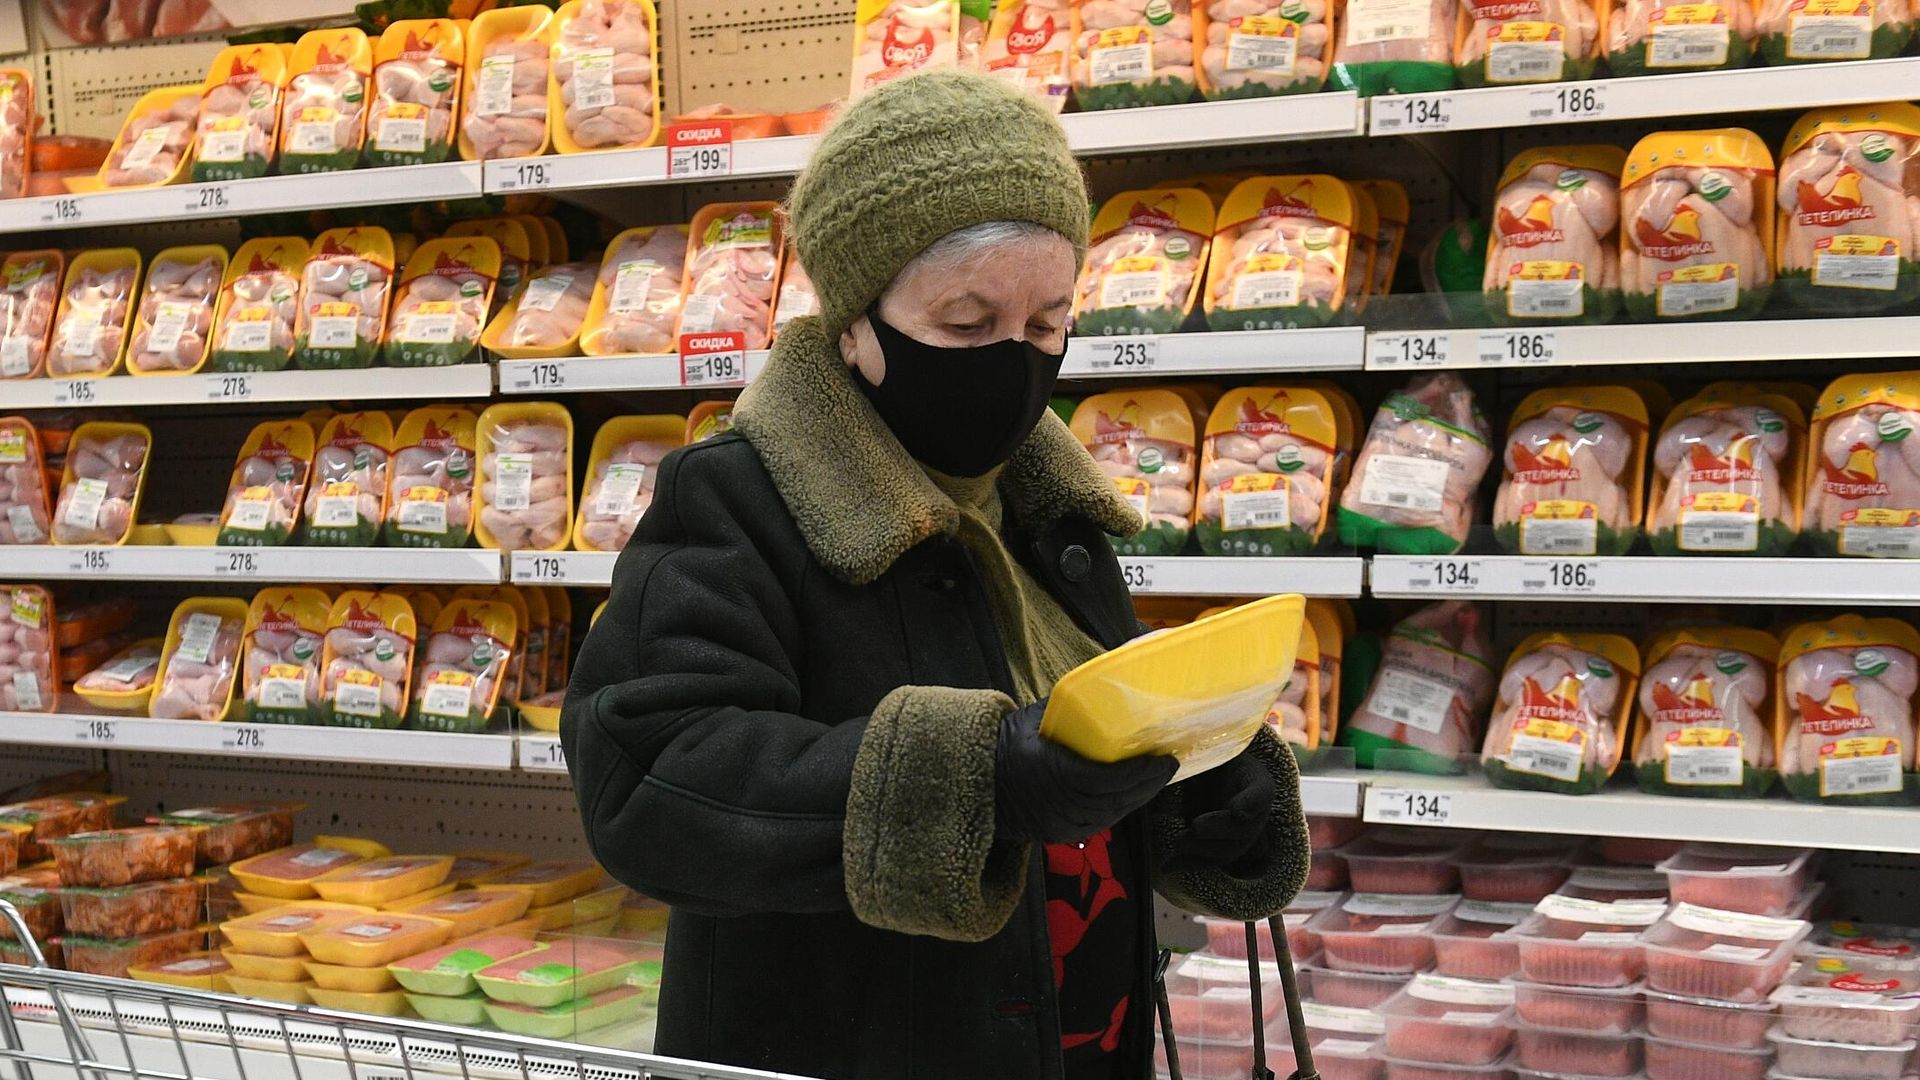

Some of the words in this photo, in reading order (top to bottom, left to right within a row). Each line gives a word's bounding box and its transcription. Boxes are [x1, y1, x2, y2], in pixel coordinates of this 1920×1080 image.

[1557, 88, 1596, 113] 186
[1405, 99, 1441, 124] 134
[676, 127, 723, 141] СКИДКА
[692, 149, 720, 170] 199
[518, 165, 544, 185] 179
[200, 188, 223, 207] 278
[55, 200, 77, 218] 185
[1799, 206, 1874, 226] ПЕТЕЛИНКА
[689, 337, 735, 350] СКИДКА
[1402, 337, 1438, 362] 134
[1507, 335, 1545, 358] 186
[1114, 343, 1147, 365] 253
[532, 364, 558, 385] 179
[705, 356, 733, 377] 199
[69, 382, 90, 399] 185
[223, 377, 246, 396] 278
[84, 550, 105, 568] 185
[229, 553, 252, 571] 278
[534, 558, 559, 578] 179
[1124, 565, 1144, 587] 53
[1434, 561, 1470, 585] 134
[1549, 563, 1588, 586] 186
[89, 721, 110, 738] 185
[1799, 715, 1875, 733] ПЕТЕЛИНКА
[237, 728, 259, 746] 278
[549, 743, 563, 763] 17
[1405, 795, 1440, 818] 134
